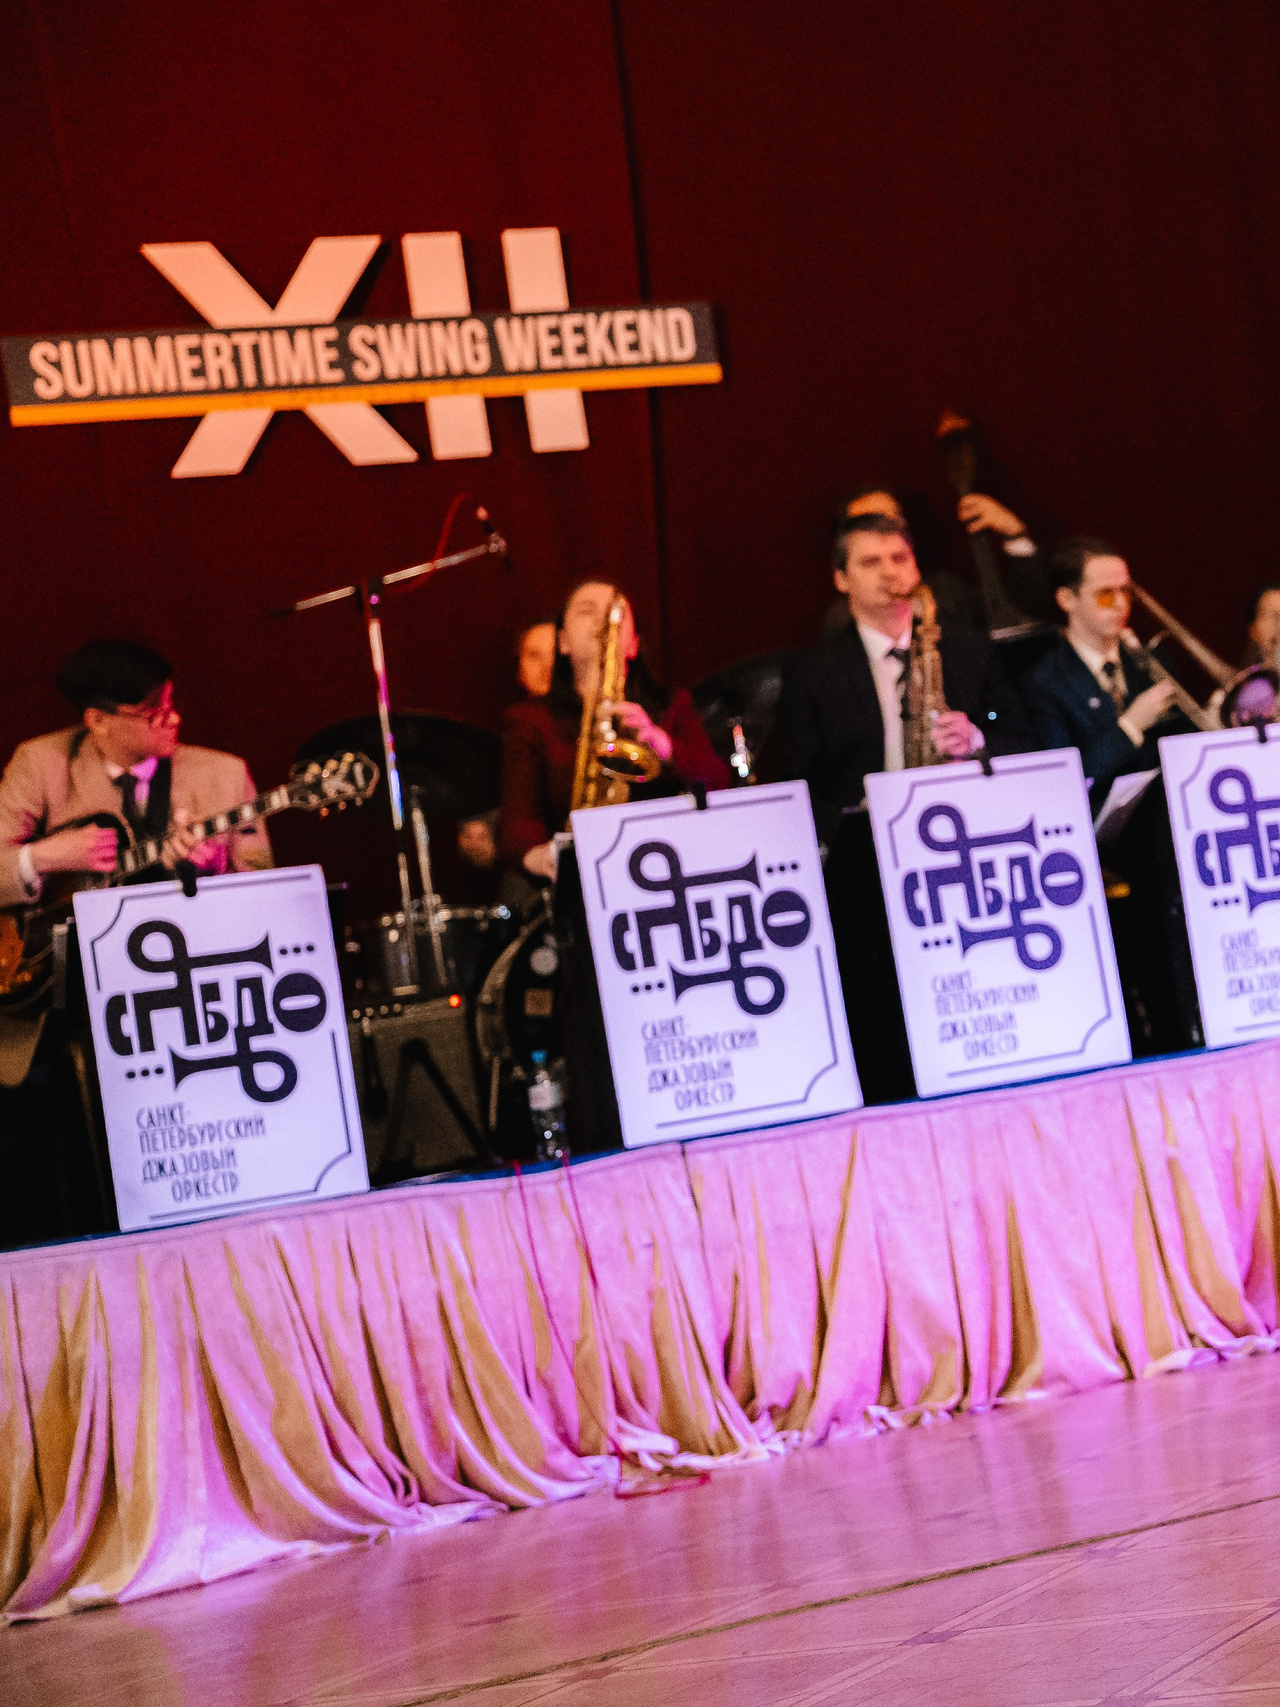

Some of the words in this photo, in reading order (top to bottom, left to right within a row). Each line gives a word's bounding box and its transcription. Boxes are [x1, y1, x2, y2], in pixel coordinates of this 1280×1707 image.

[29, 326, 345, 400] SUMMERTIME
[348, 316, 493, 382] SWING
[494, 307, 698, 373] WEEKEND
[140, 226, 592, 479] XII
[171, 1171, 240, 1203] ОРКЕСТР
